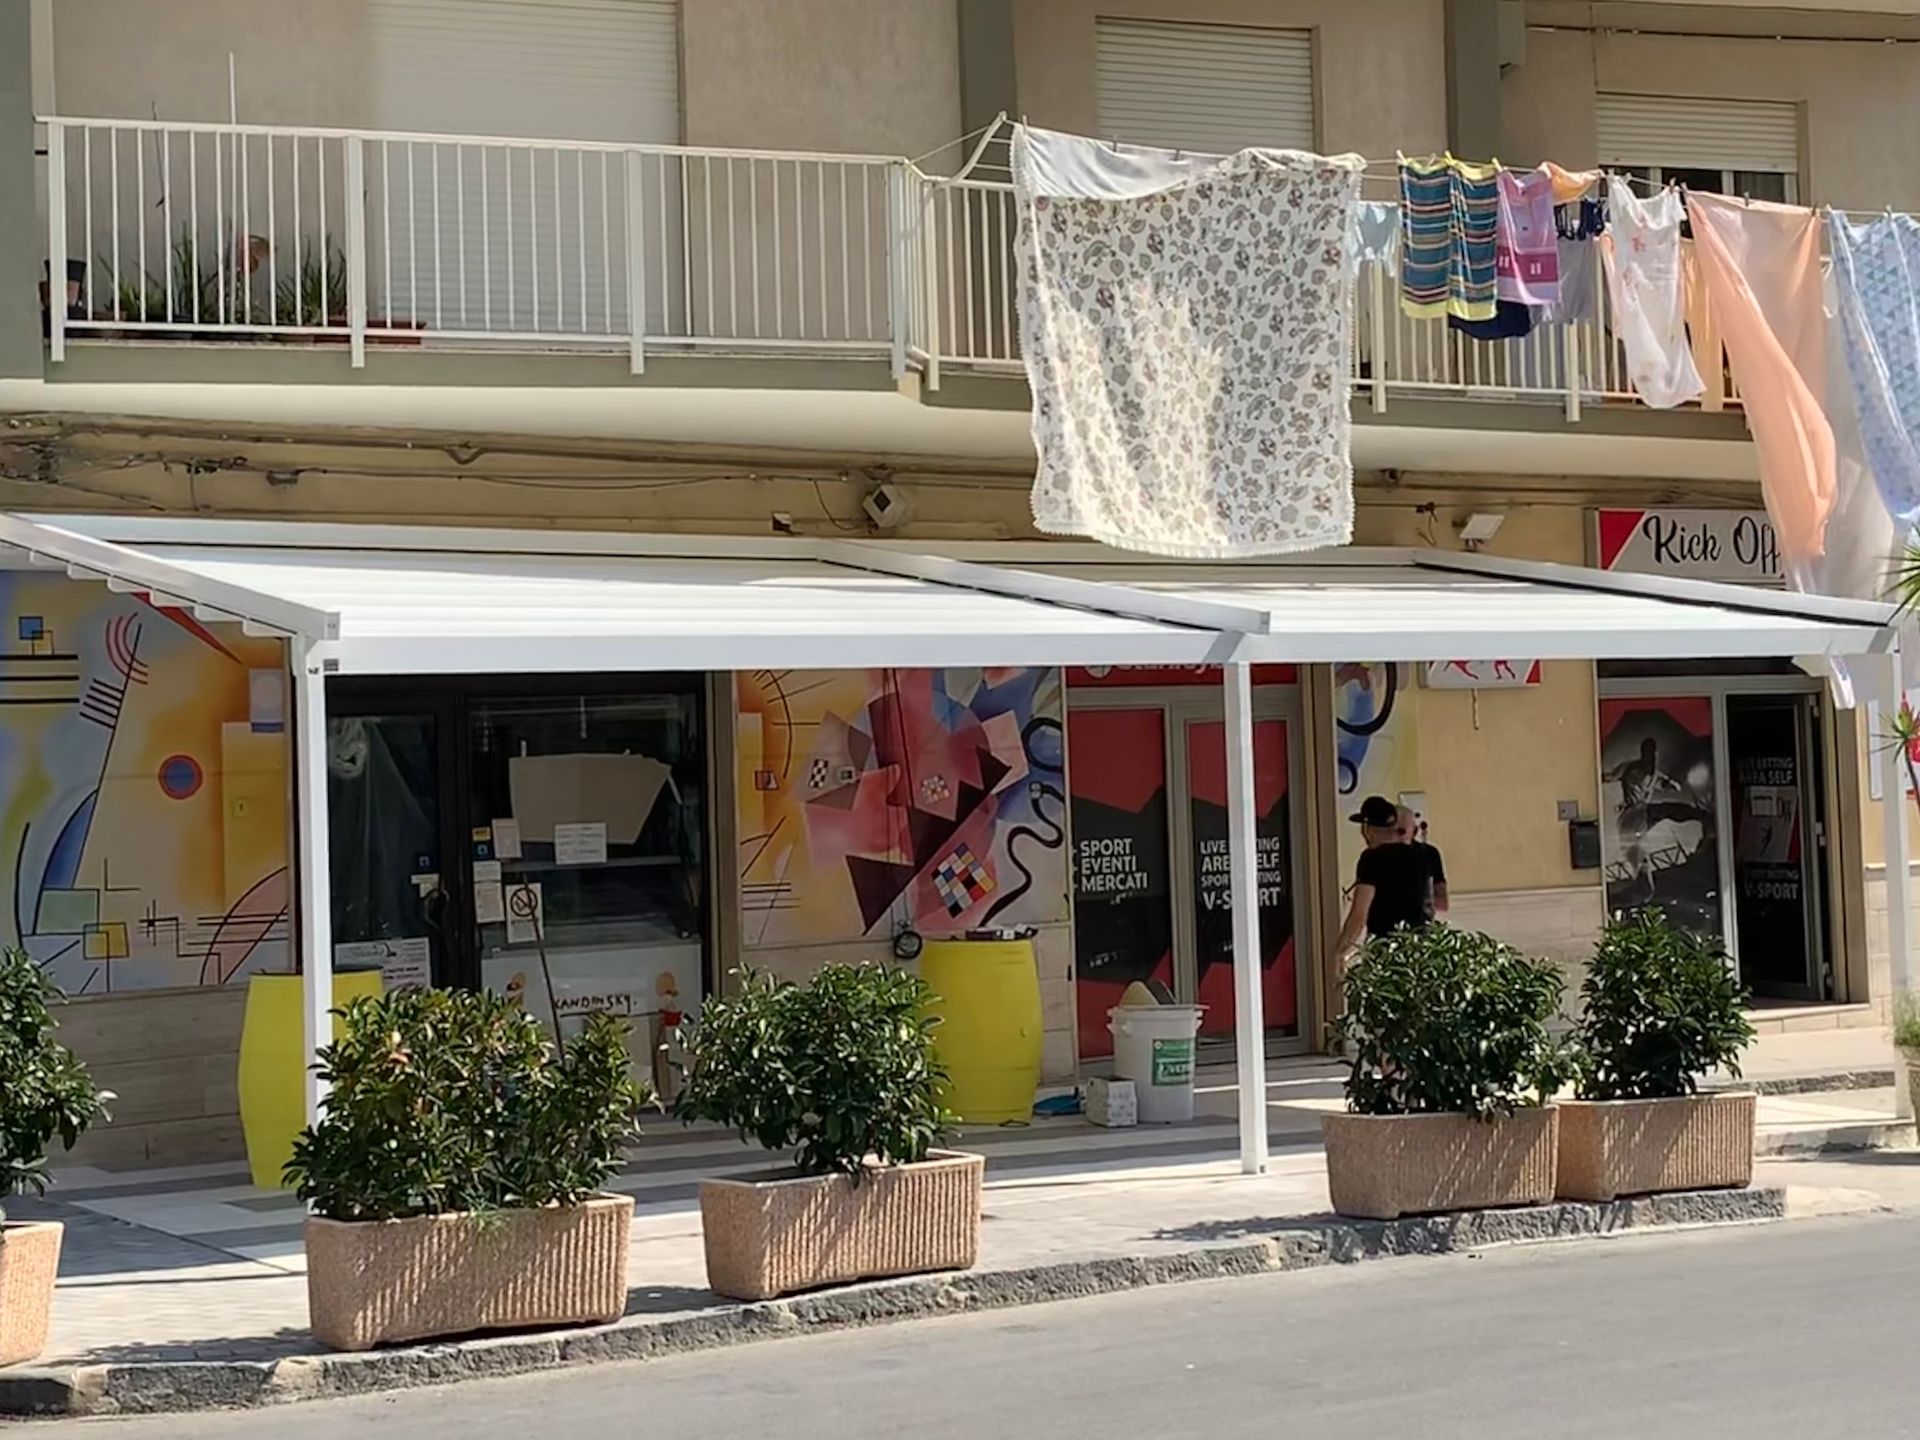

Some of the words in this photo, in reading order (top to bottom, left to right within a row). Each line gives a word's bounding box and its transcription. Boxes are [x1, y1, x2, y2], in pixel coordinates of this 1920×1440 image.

[1643, 515, 1722, 564] Kick
[1733, 516, 1781, 574] Off
[1767, 770, 1793, 785] SELF
[1080, 838, 1133, 857] SPORT
[1200, 840, 1228, 855] LIVE
[1081, 855, 1137, 875] EVENTI
[1201, 855, 1230, 873] ARE
[1256, 852, 1280, 868] ELF
[1081, 872, 1148, 893] MERCATI
[1200, 874, 1229, 889] SPOR
[1202, 887, 1281, 911] V-SRT
